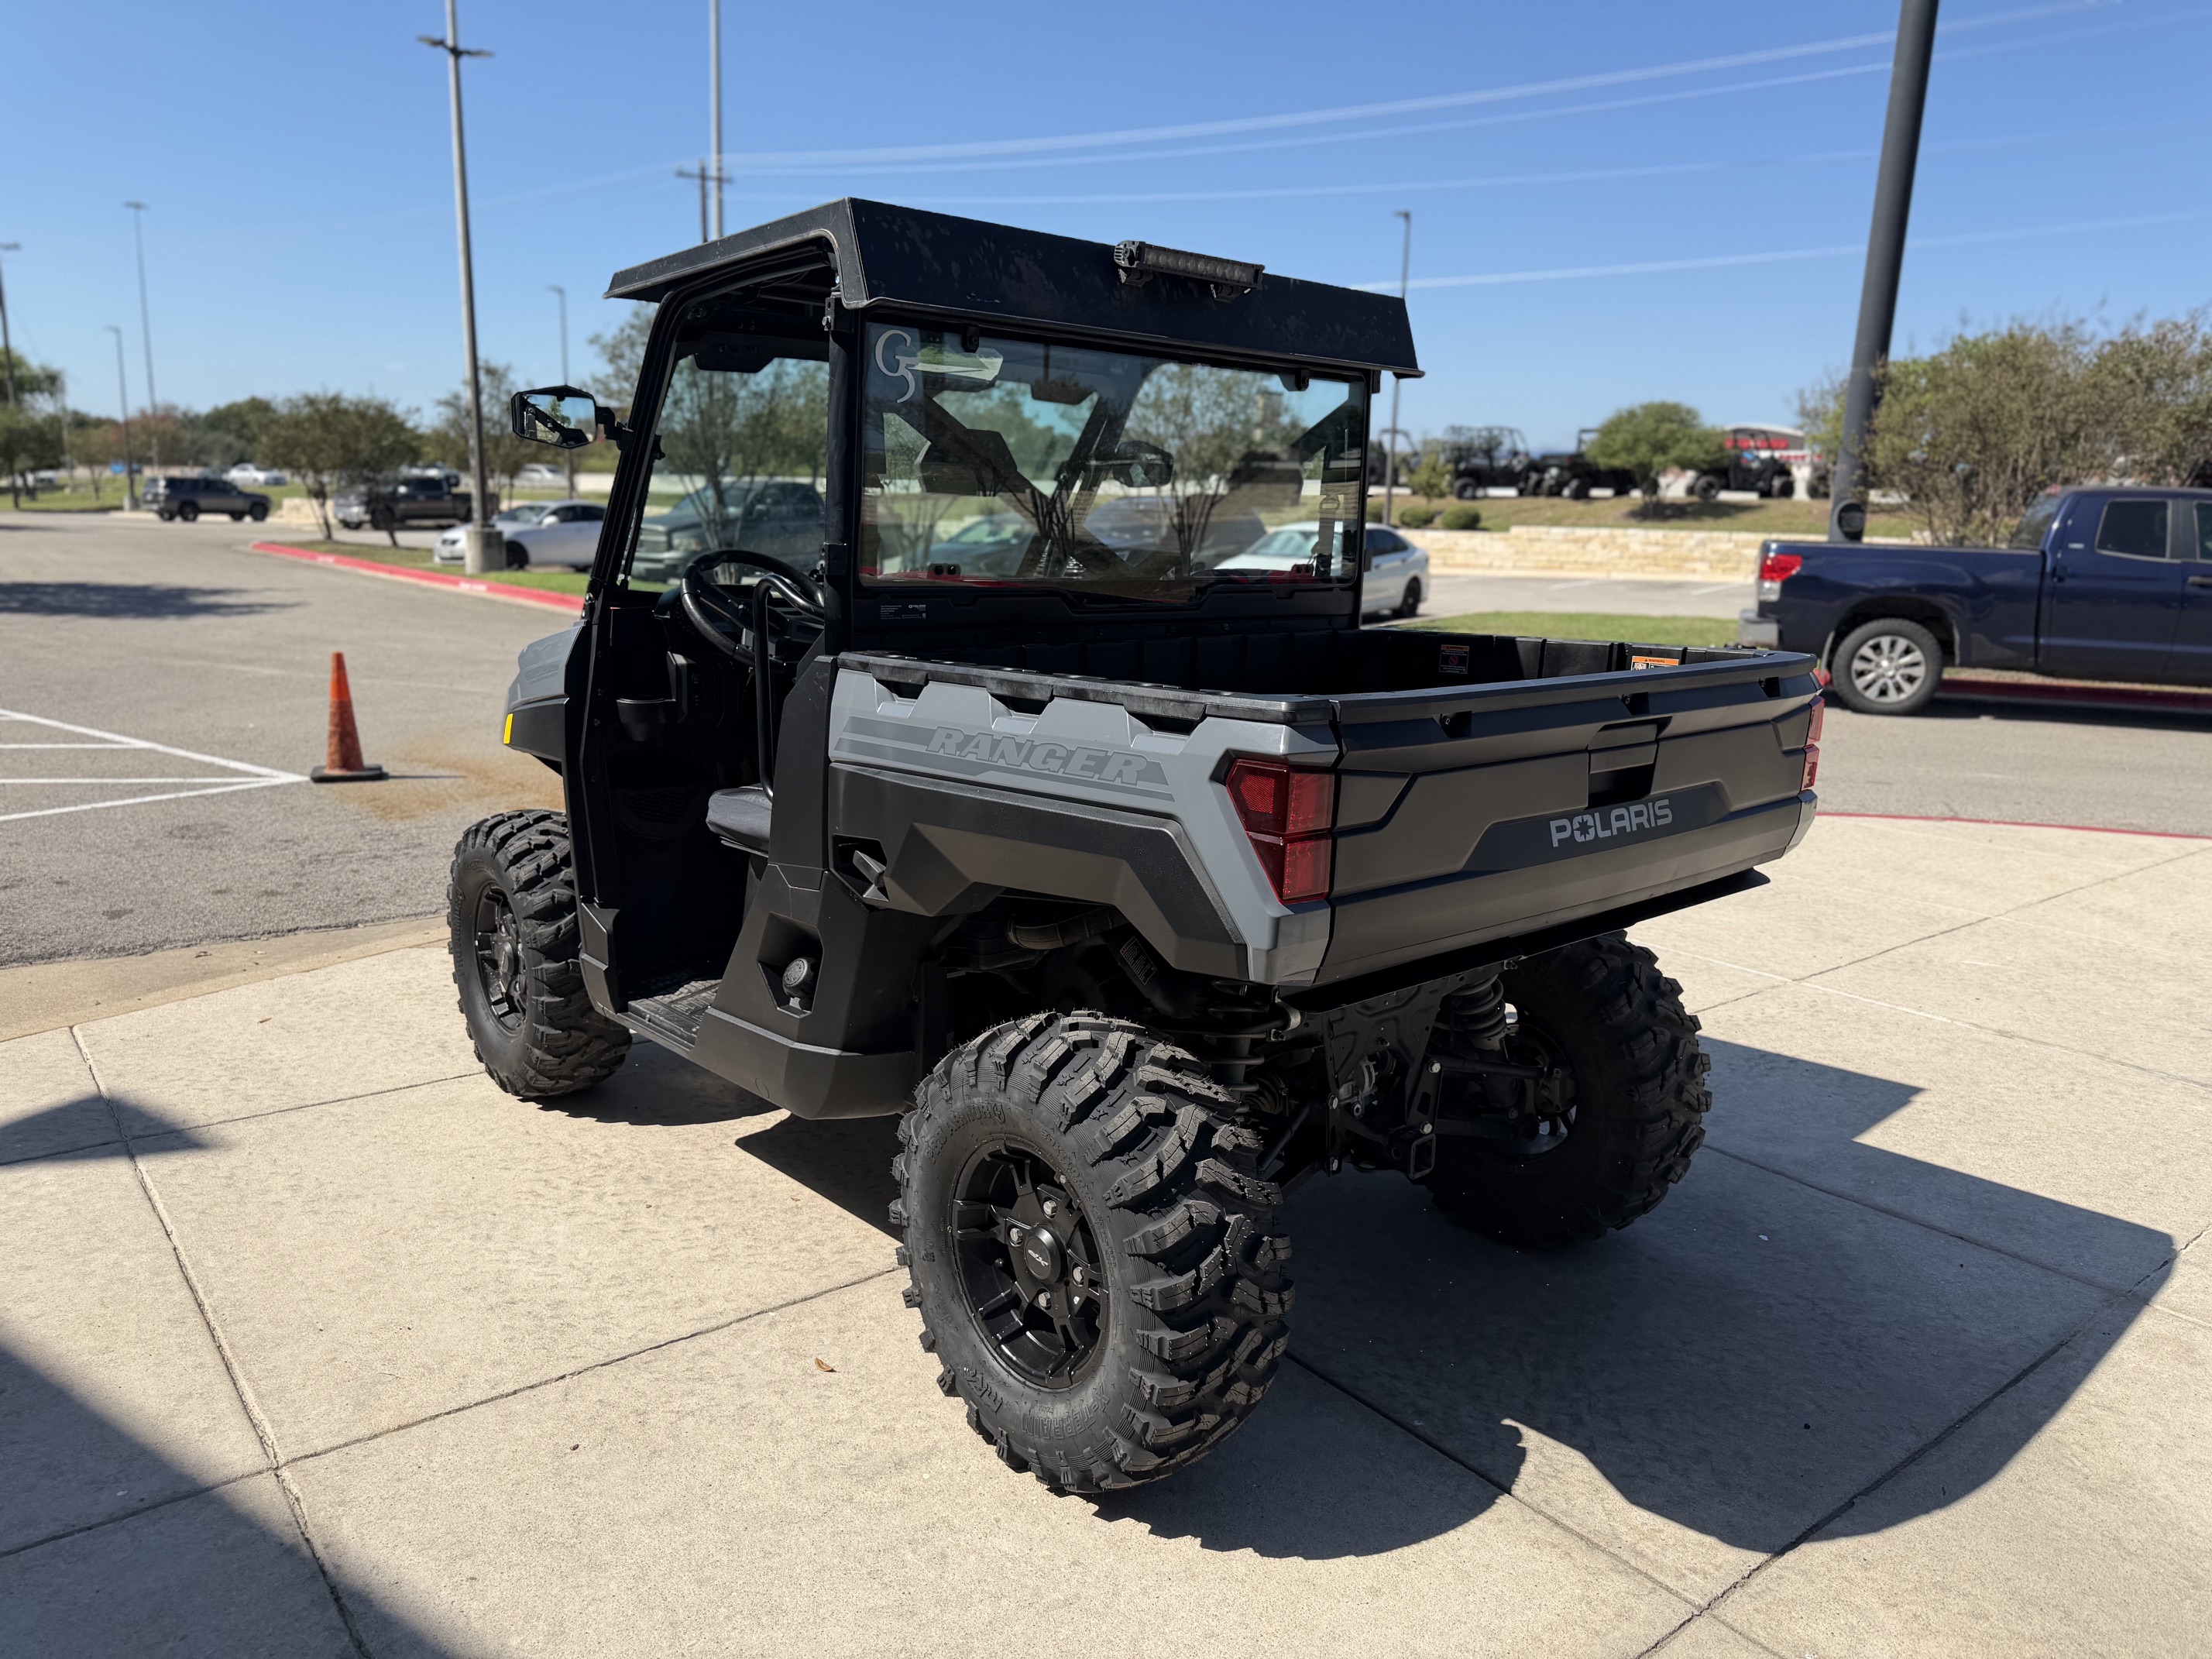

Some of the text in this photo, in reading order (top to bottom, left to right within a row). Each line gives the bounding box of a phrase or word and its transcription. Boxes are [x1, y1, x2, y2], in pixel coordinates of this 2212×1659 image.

[926, 726, 1149, 786] RANGER
[1549, 799, 1673, 848] POLARIS
[924, 1101, 992, 1165] PRO ARMOR
